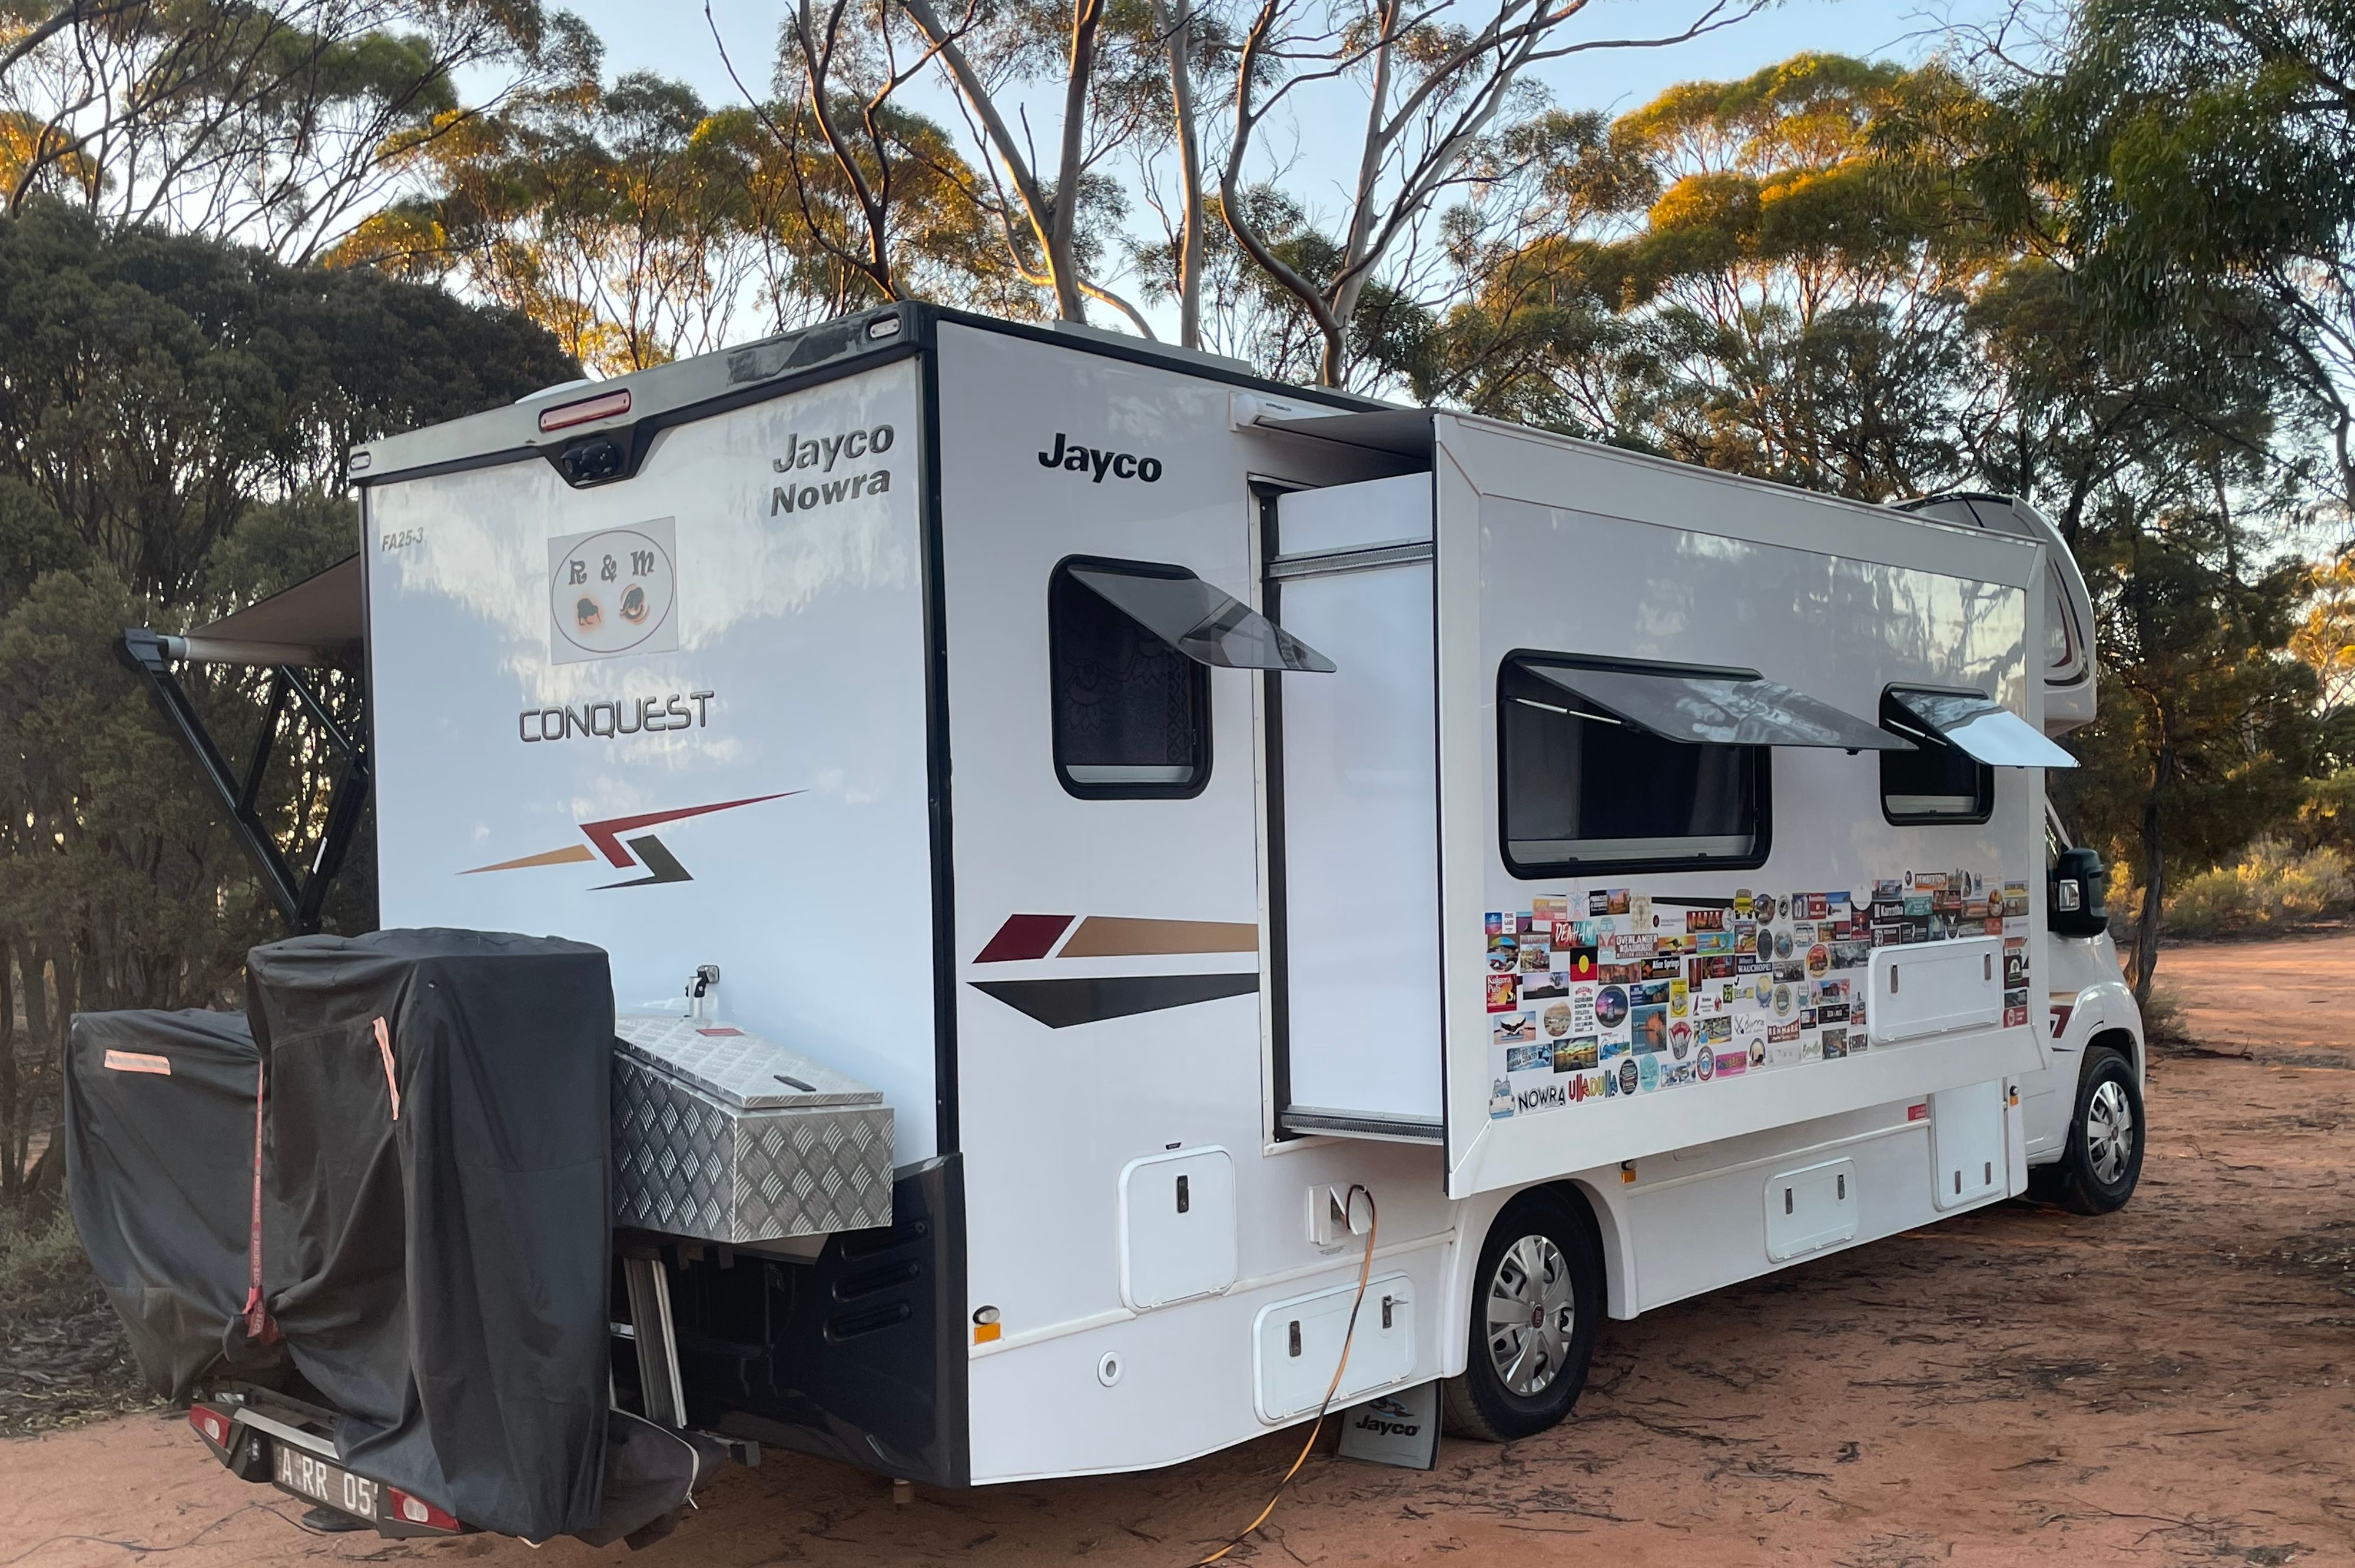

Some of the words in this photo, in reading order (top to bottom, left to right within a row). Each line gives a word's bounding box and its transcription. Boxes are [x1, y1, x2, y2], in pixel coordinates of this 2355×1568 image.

[772, 424, 894, 473] Jayco
[1039, 433, 1162, 483] Jayco
[771, 470, 891, 517] Nowra
[382, 527, 424, 552] FA25-3
[569, 559, 588, 586] R
[601, 554, 618, 583] &
[519, 690, 715, 743] CONQUEST
[1555, 922, 1594, 942] DENHAM
[1652, 959, 1663, 969] Alice
[1518, 1087, 1565, 1113] NOWRA
[1356, 1414, 1418, 1436] Jayco
[343, 1471, 379, 1521] 05
